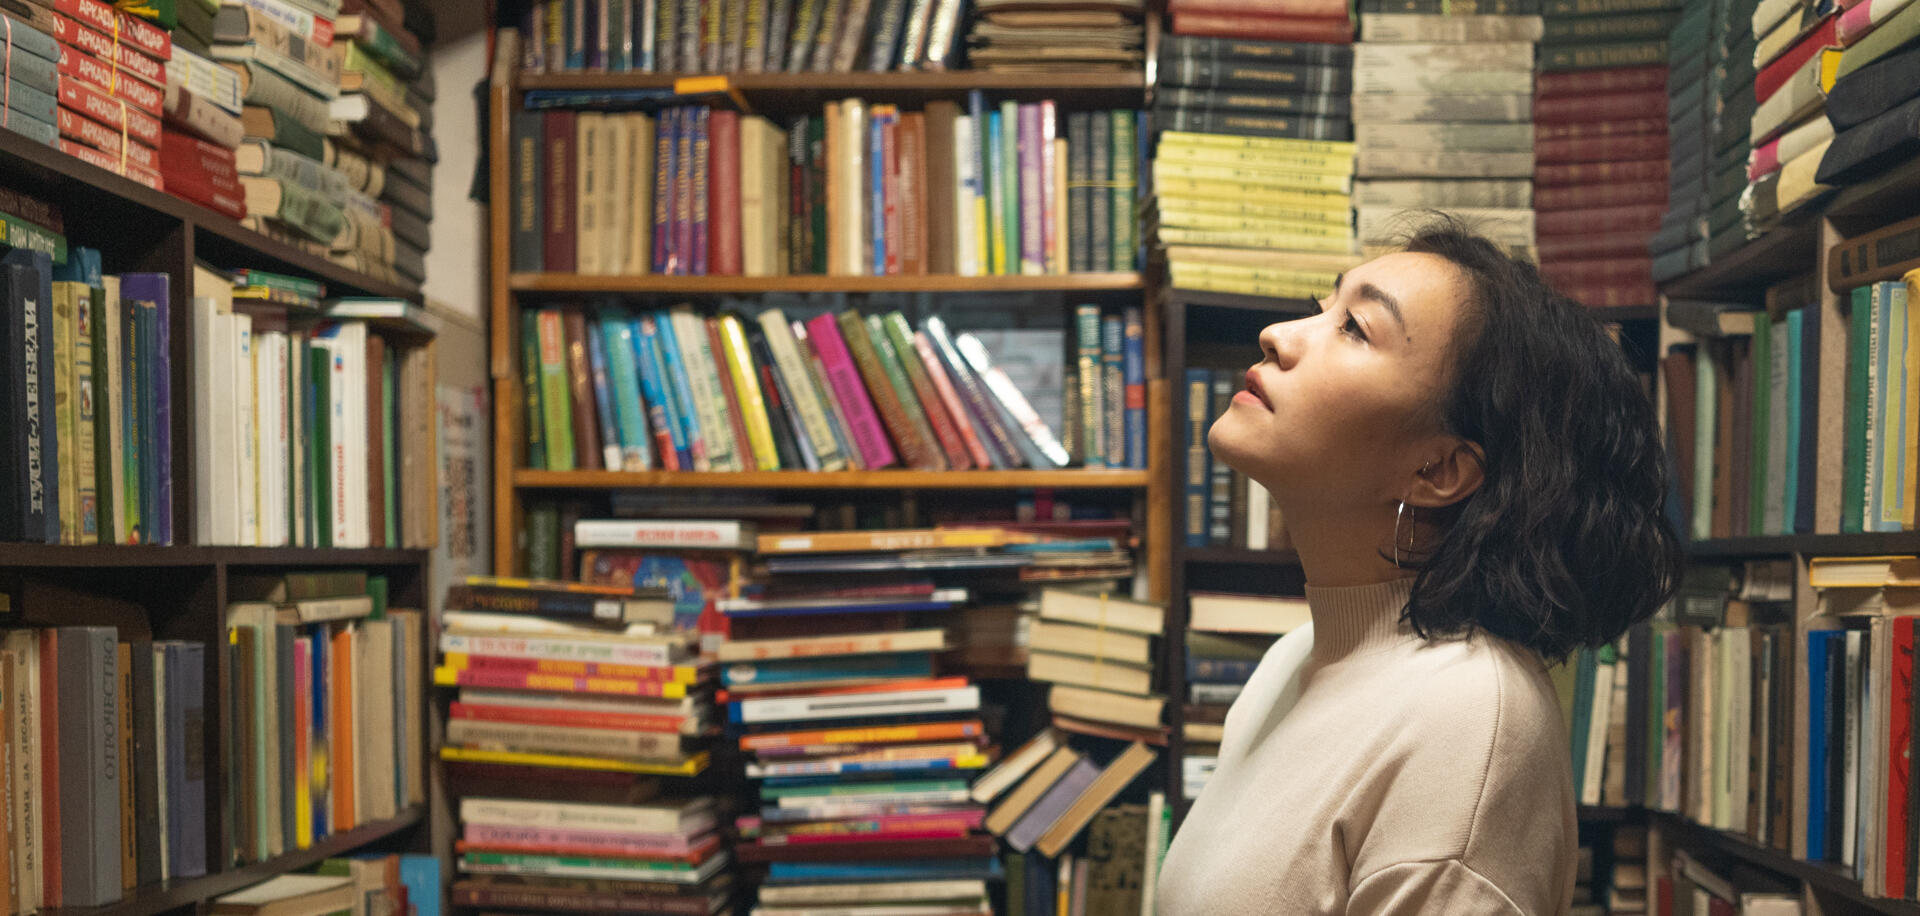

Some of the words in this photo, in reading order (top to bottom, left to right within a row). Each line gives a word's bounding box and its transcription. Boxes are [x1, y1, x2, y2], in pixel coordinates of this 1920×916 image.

[77, 28, 122, 62] АРКАДИЙ
[124, 48, 159, 79] ГАЙДАР
[79, 58, 121, 91] АРКАДИЙ
[124, 78, 158, 107] ГАЙДАР
[103, 636, 115, 781] ОТРОЧЕСТВО
